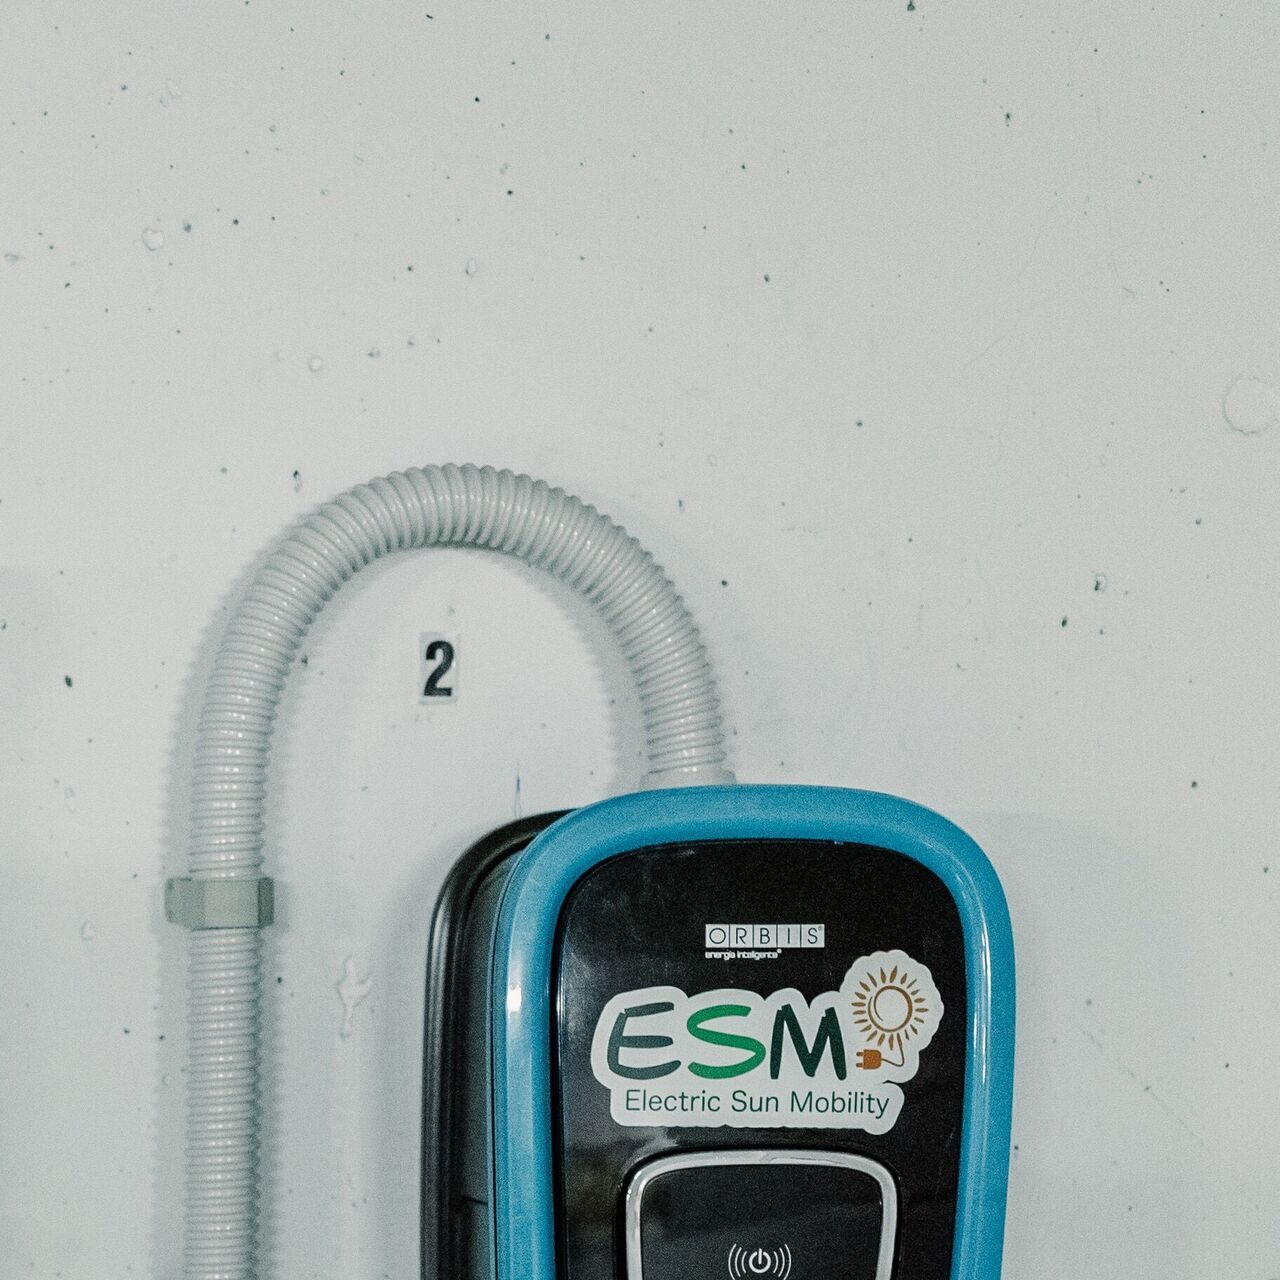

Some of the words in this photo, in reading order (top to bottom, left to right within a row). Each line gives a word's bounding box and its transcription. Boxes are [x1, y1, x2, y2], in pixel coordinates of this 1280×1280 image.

[424, 640, 455, 697] 2
[708, 927, 819, 945] ORBIS
[606, 1002, 848, 1082] ESM
[626, 1089, 720, 1112] Electric
[731, 1089, 779, 1112] Sun
[790, 1091, 889, 1119] Mobility
